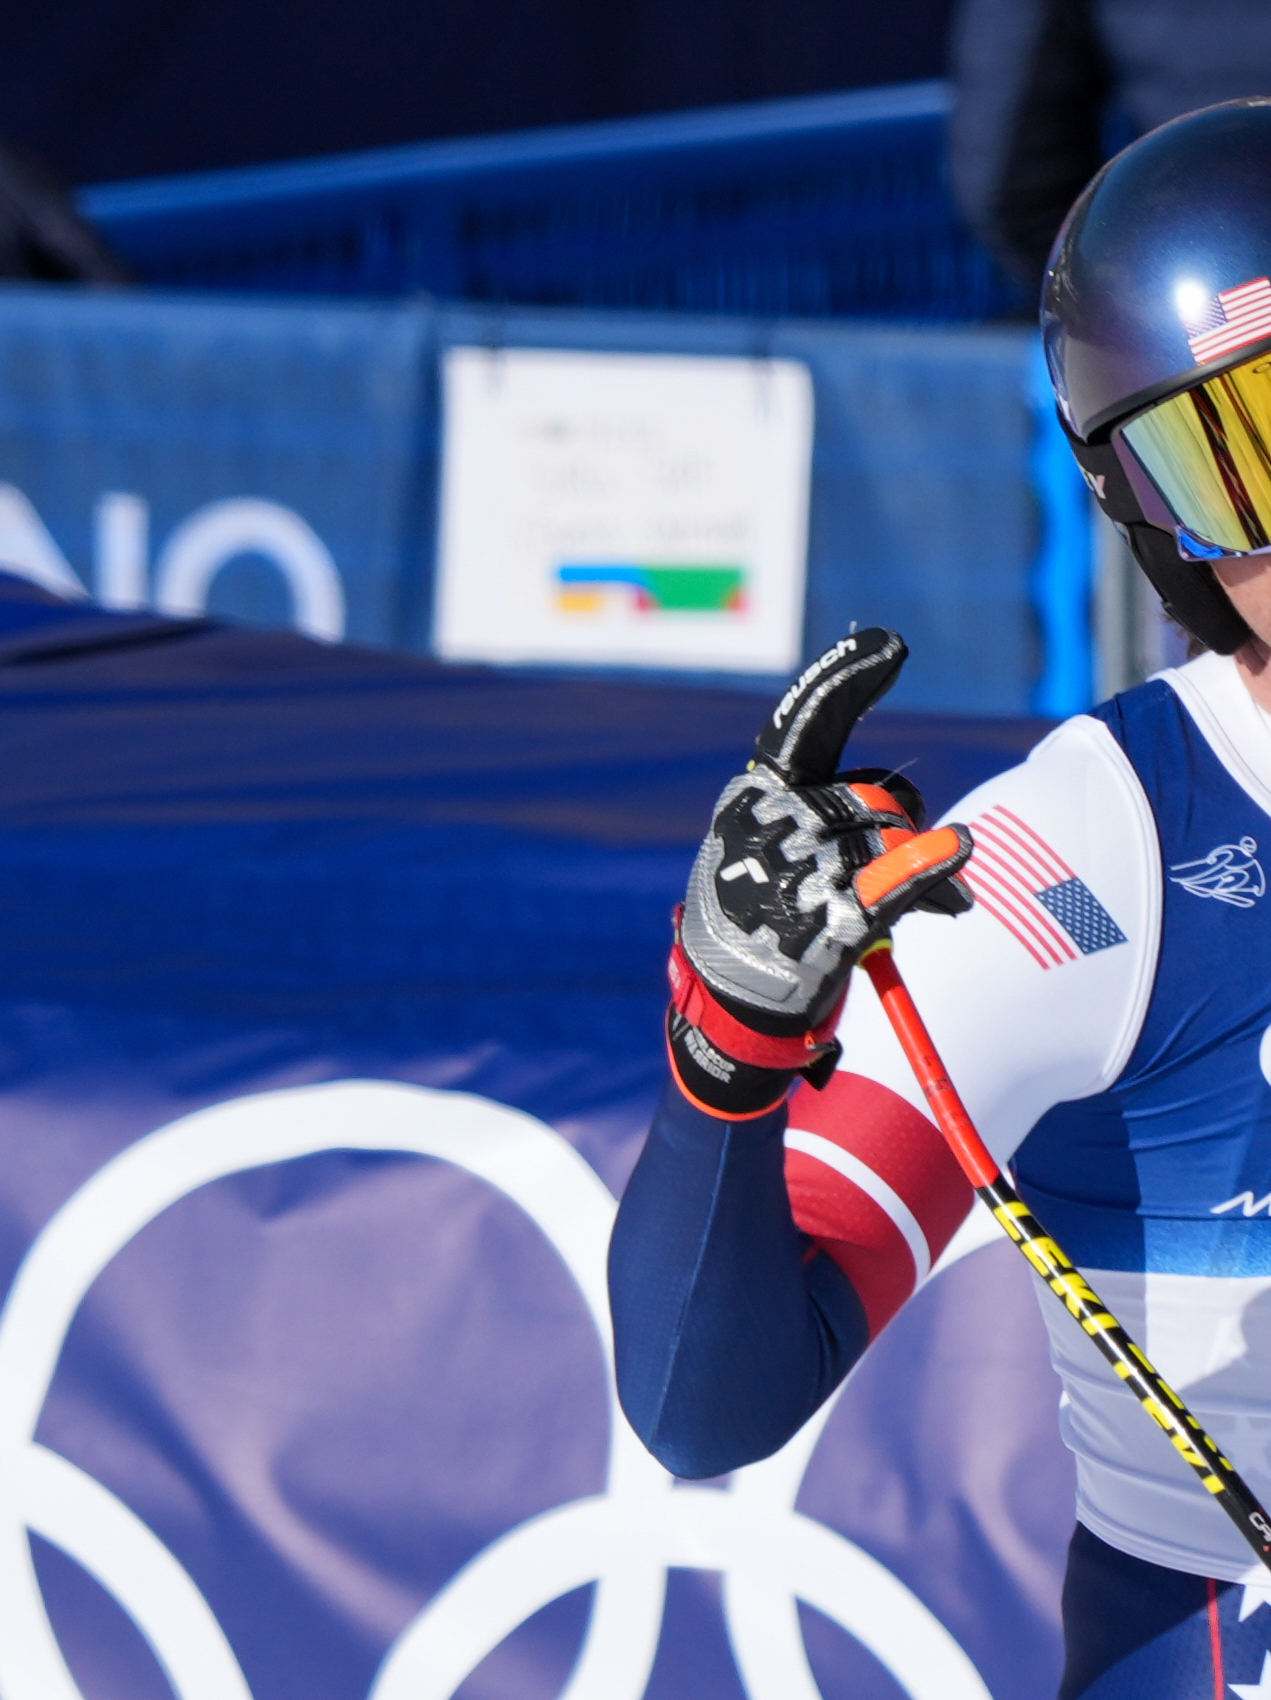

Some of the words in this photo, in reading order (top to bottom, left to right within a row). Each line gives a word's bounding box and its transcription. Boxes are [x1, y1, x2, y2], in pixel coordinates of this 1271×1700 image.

[773, 638, 857, 729] reusch
[684, 1029, 732, 1084] WARRIOR
[994, 1202, 1119, 1336] LEKI
